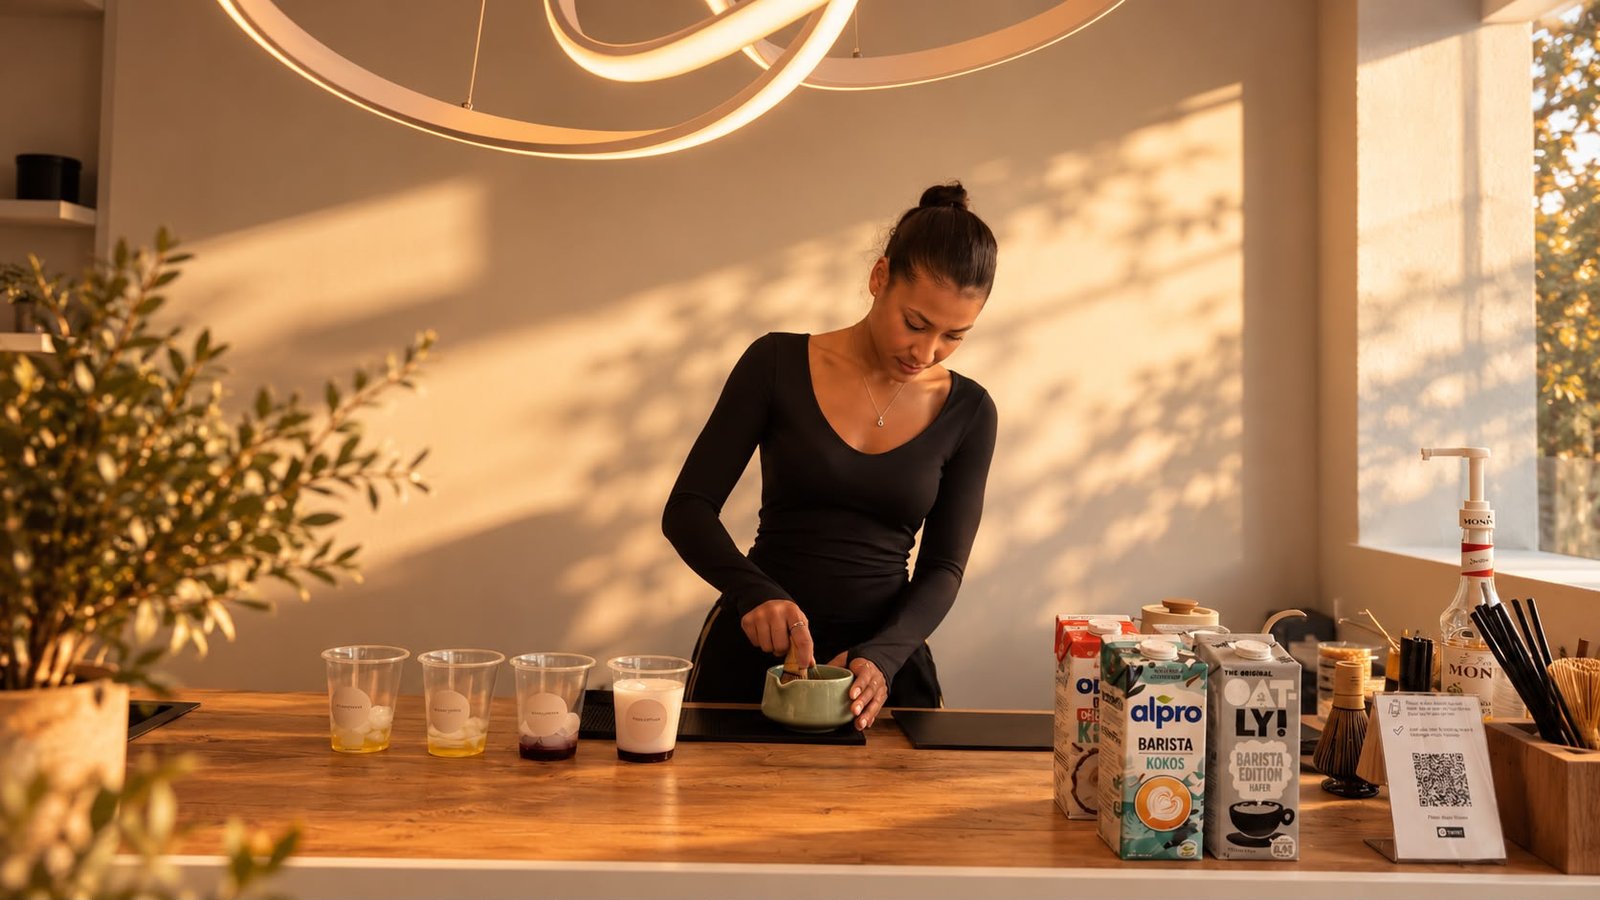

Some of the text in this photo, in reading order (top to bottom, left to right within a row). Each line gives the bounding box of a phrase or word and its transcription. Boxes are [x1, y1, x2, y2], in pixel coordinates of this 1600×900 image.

[1131, 696, 1202, 729] alpro
[1236, 708, 1287, 737] LY!
[1138, 737, 1193, 751] BARISTA
[1146, 757, 1185, 770] KOKOS
[1236, 752, 1284, 767] BARISTA
[1238, 767, 1283, 782] EDITION
[1249, 783, 1271, 792] HAFER
